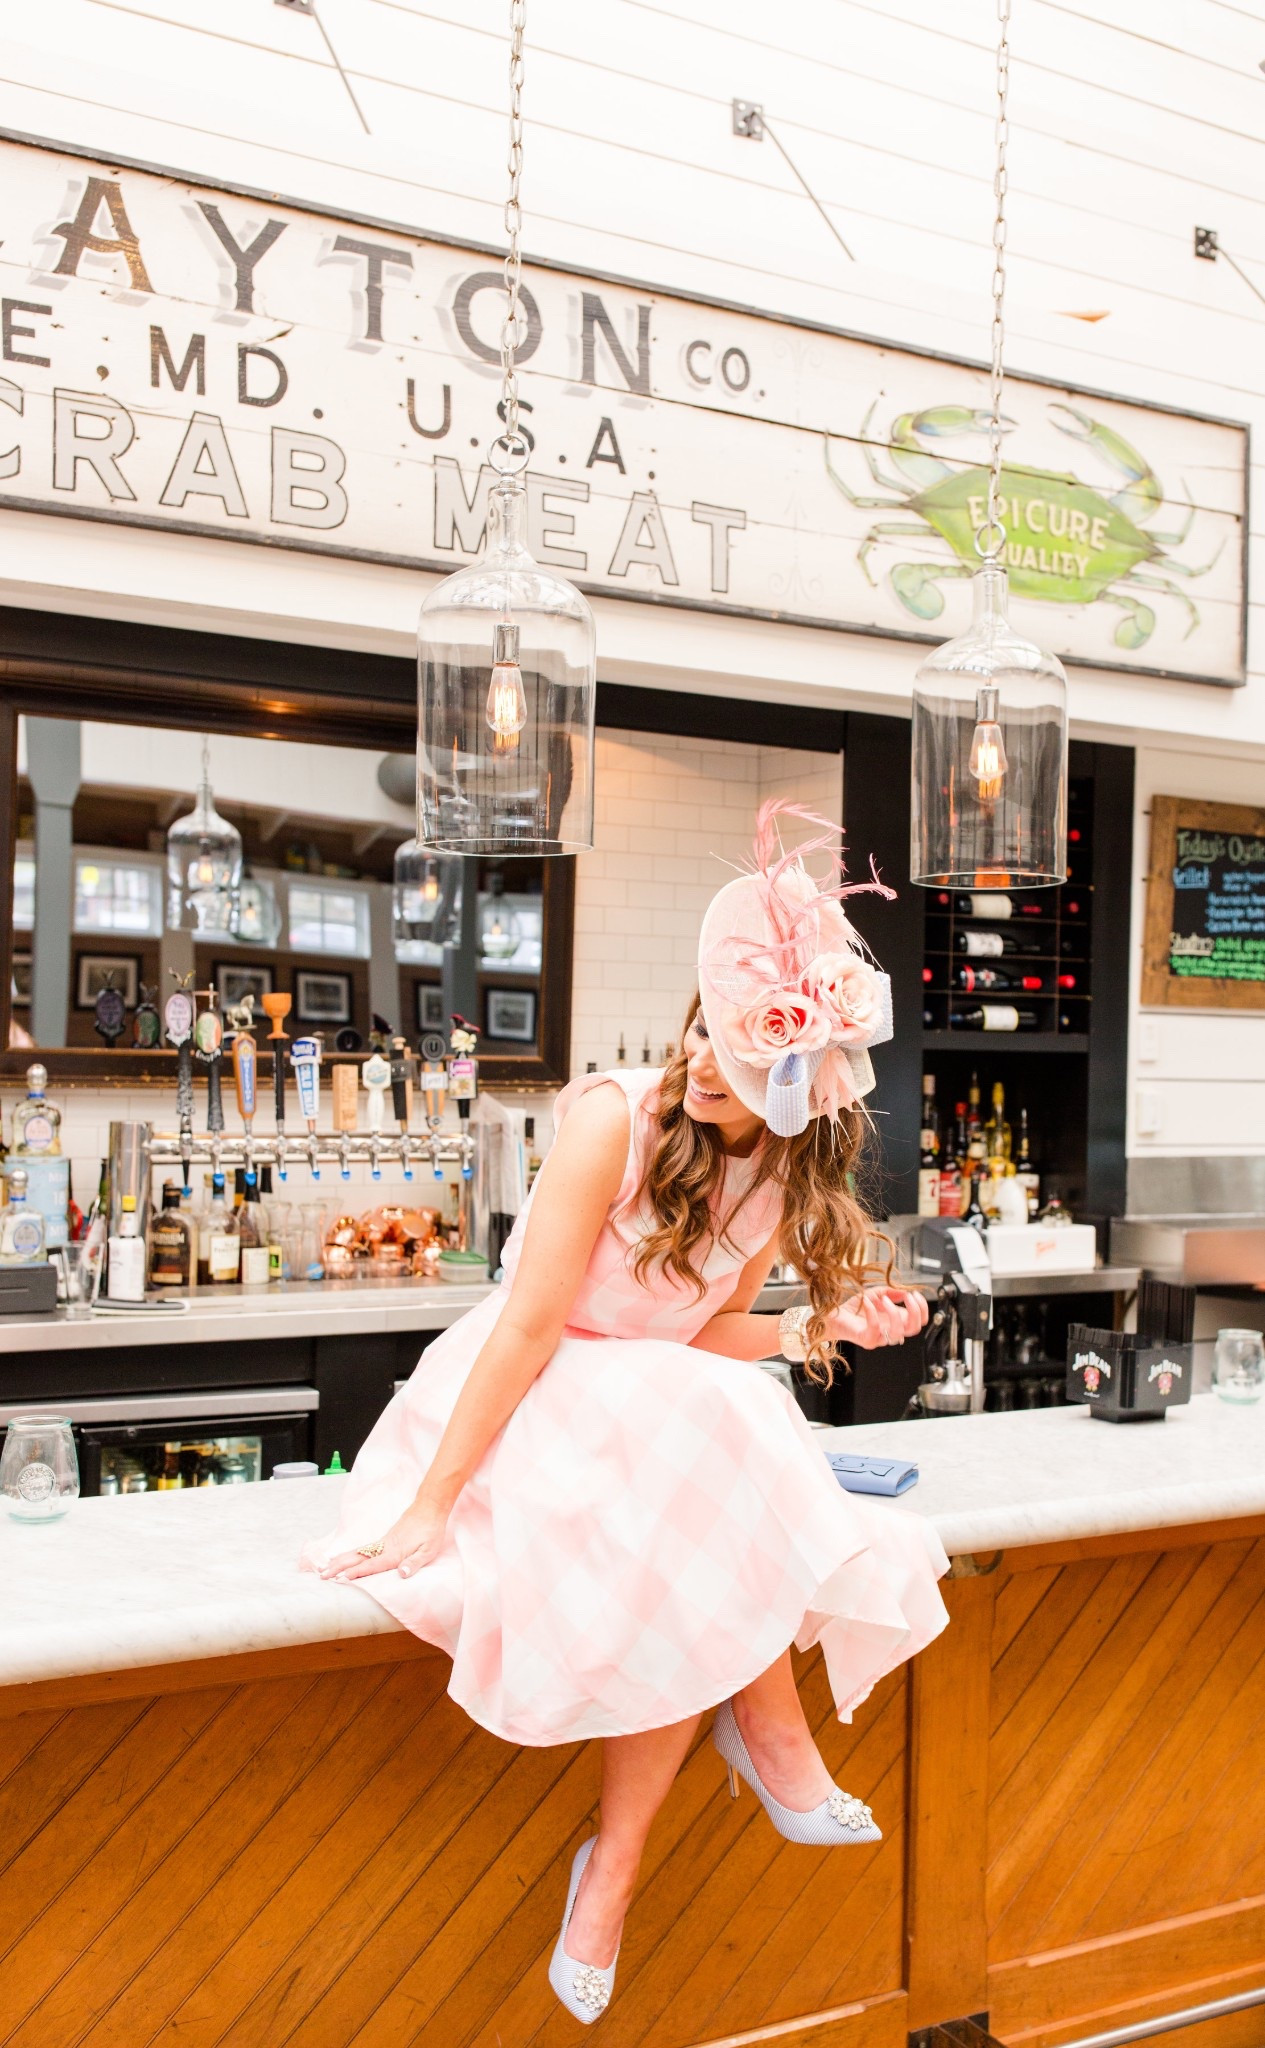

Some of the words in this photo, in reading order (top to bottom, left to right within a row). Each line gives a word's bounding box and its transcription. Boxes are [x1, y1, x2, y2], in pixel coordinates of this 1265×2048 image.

[0, 176, 655, 397] AYTON
[685, 339, 767, 399] CO.
[149, 325, 324, 420] MD.
[433, 455, 747, 593] MEAT
[967, 496, 1110, 551] EPICURE
[1072, 1352, 1089, 1372] JIM
[1088, 1351, 1111, 1379] BEAM
[1162, 1359, 1182, 1378] BEAM
